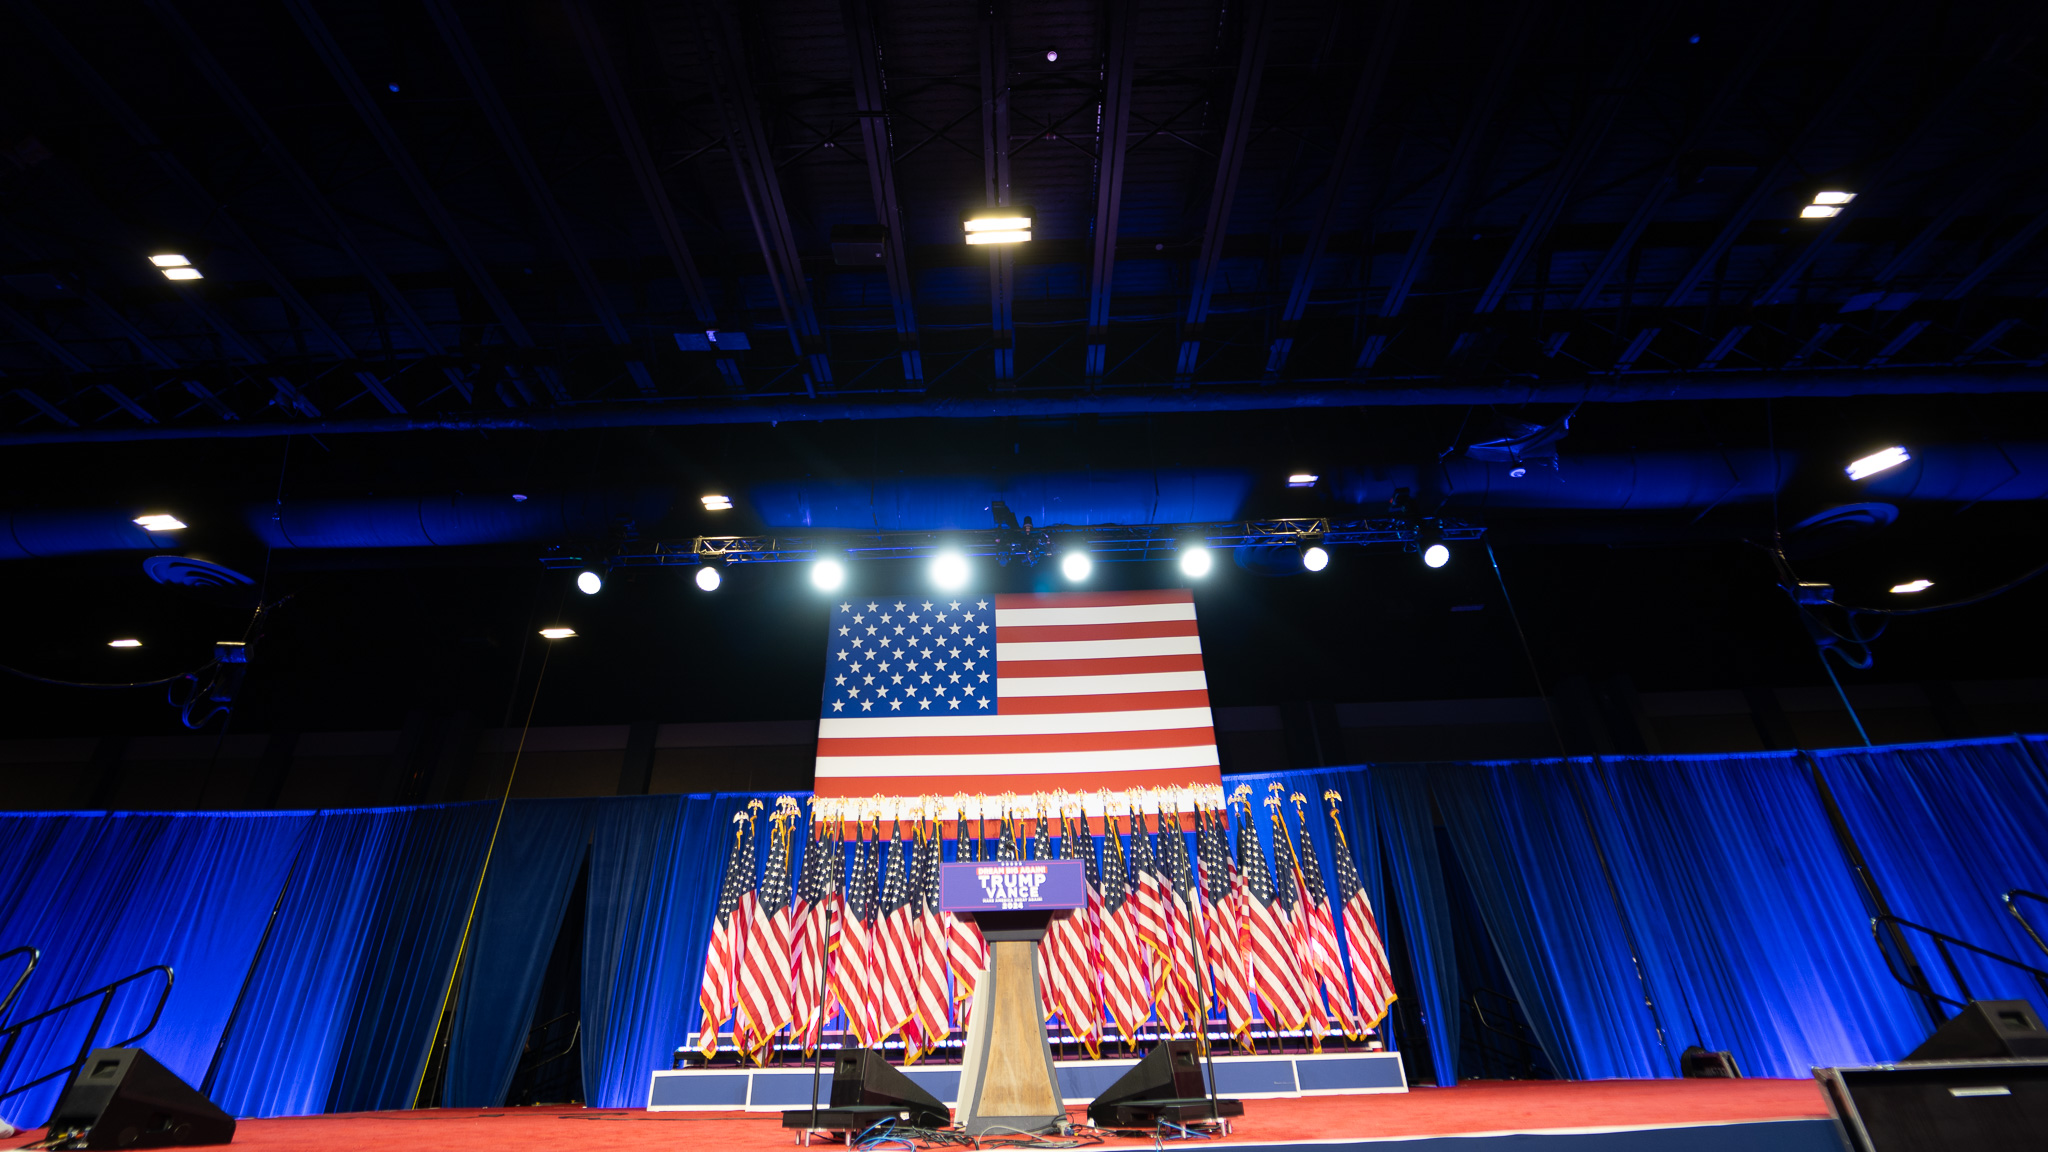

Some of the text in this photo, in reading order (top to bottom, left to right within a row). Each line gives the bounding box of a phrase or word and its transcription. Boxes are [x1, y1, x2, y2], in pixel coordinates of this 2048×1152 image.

[978, 865, 1046, 875] DREAM BIG AGAIN!
[978, 874, 1046, 888] TRUMP
[986, 886, 1039, 898] VANCE
